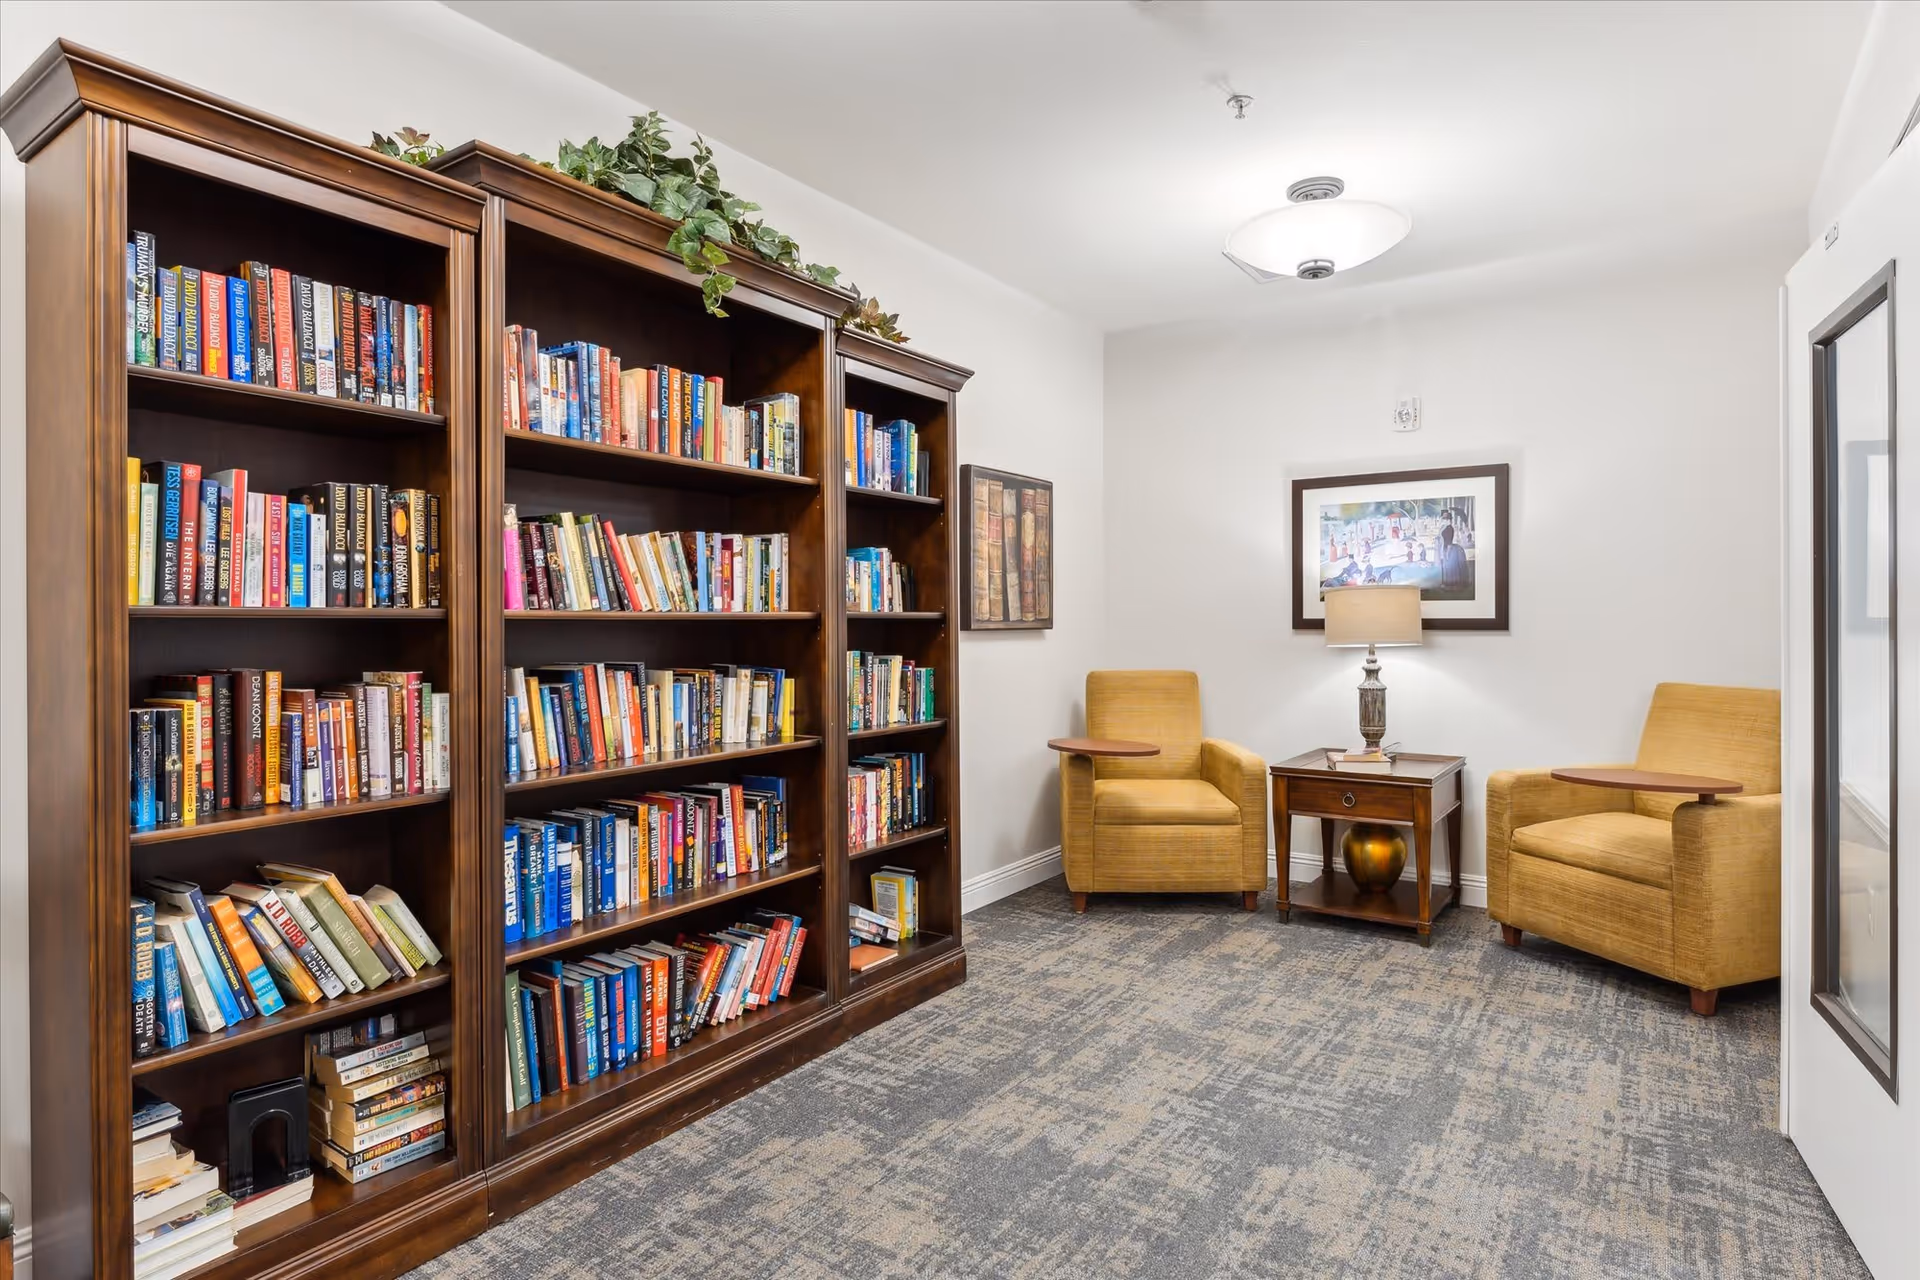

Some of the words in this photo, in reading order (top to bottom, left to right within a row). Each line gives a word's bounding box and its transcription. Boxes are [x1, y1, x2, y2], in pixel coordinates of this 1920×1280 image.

[137, 235, 149, 287] TRUMAN'S
[164, 285, 175, 312] DAVID
[184, 280, 196, 306] DAVID
[209, 289, 219, 311] DAVID
[256, 279, 266, 303] DAVID
[301, 282, 312, 308] DAVID
[137, 291, 149, 333] MURDER
[235, 297, 244, 317] DAVID
[342, 302, 354, 328] DAVID
[360, 306, 372, 335] DAVID
[164, 314, 176, 357] BALDACCI
[184, 308, 197, 350] BALDACCI
[209, 313, 220, 347] BALDACCI
[236, 319, 245, 353] BALDACCI
[257, 305, 269, 343] BALDACCI
[302, 310, 313, 350] BALDACCI
[257, 348, 266, 376] SHADOWS
[343, 329, 355, 372] BALDACCI
[361, 336, 374, 386] BALDACCI
[318, 362, 326, 390] CORNER
[167, 465, 180, 488] TESS
[207, 487, 217, 504] BONE
[335, 487, 345, 510] DAVID
[356, 487, 365, 511] DAVID
[415, 493, 423, 510] JOHN
[165, 490, 179, 539] GERRITSEN
[206, 508, 216, 536] CANYON
[222, 507, 231, 521] LOST
[415, 512, 425, 541] GRISHAM
[184, 521, 194, 542] THE
[205, 539, 215, 552] LEE
[221, 523, 230, 540] HILLS
[335, 513, 345, 550] BALDACCI
[356, 513, 366, 550] BALDACCI
[220, 547, 230, 558] LEE
[395, 544, 407, 562] JOHN
[165, 560, 173, 590] AGAIN
[183, 547, 193, 590] INTERN
[204, 554, 215, 590] GOLDBERG
[220, 560, 230, 589] GOLDBERG
[332, 571, 340, 588] COLD
[396, 562, 408, 594] GRISHAM
[252, 676, 261, 701] DEAN
[578, 684, 586, 709] SECOND
[186, 704, 194, 720] JOHN
[252, 703, 261, 739] KOONTZ
[186, 723, 194, 754] GRISHAM
[586, 850, 592, 863] Am
[504, 836, 518, 926] Thesaurus
[279, 916, 309, 950] ROBB
[334, 920, 361, 957] SEARCH
[308, 944, 336, 982] FAITHLESS
[308, 960, 328, 984] DEATH
[675, 955, 685, 979] STRANGE
[135, 1004, 145, 1034] DEATH
[145, 986, 154, 1037] FORGOTTEN
[512, 1001, 522, 1038] Complete
[656, 1016, 665, 1043] OUT
[518, 1059, 523, 1067] of
[518, 1068, 526, 1086] Golf
